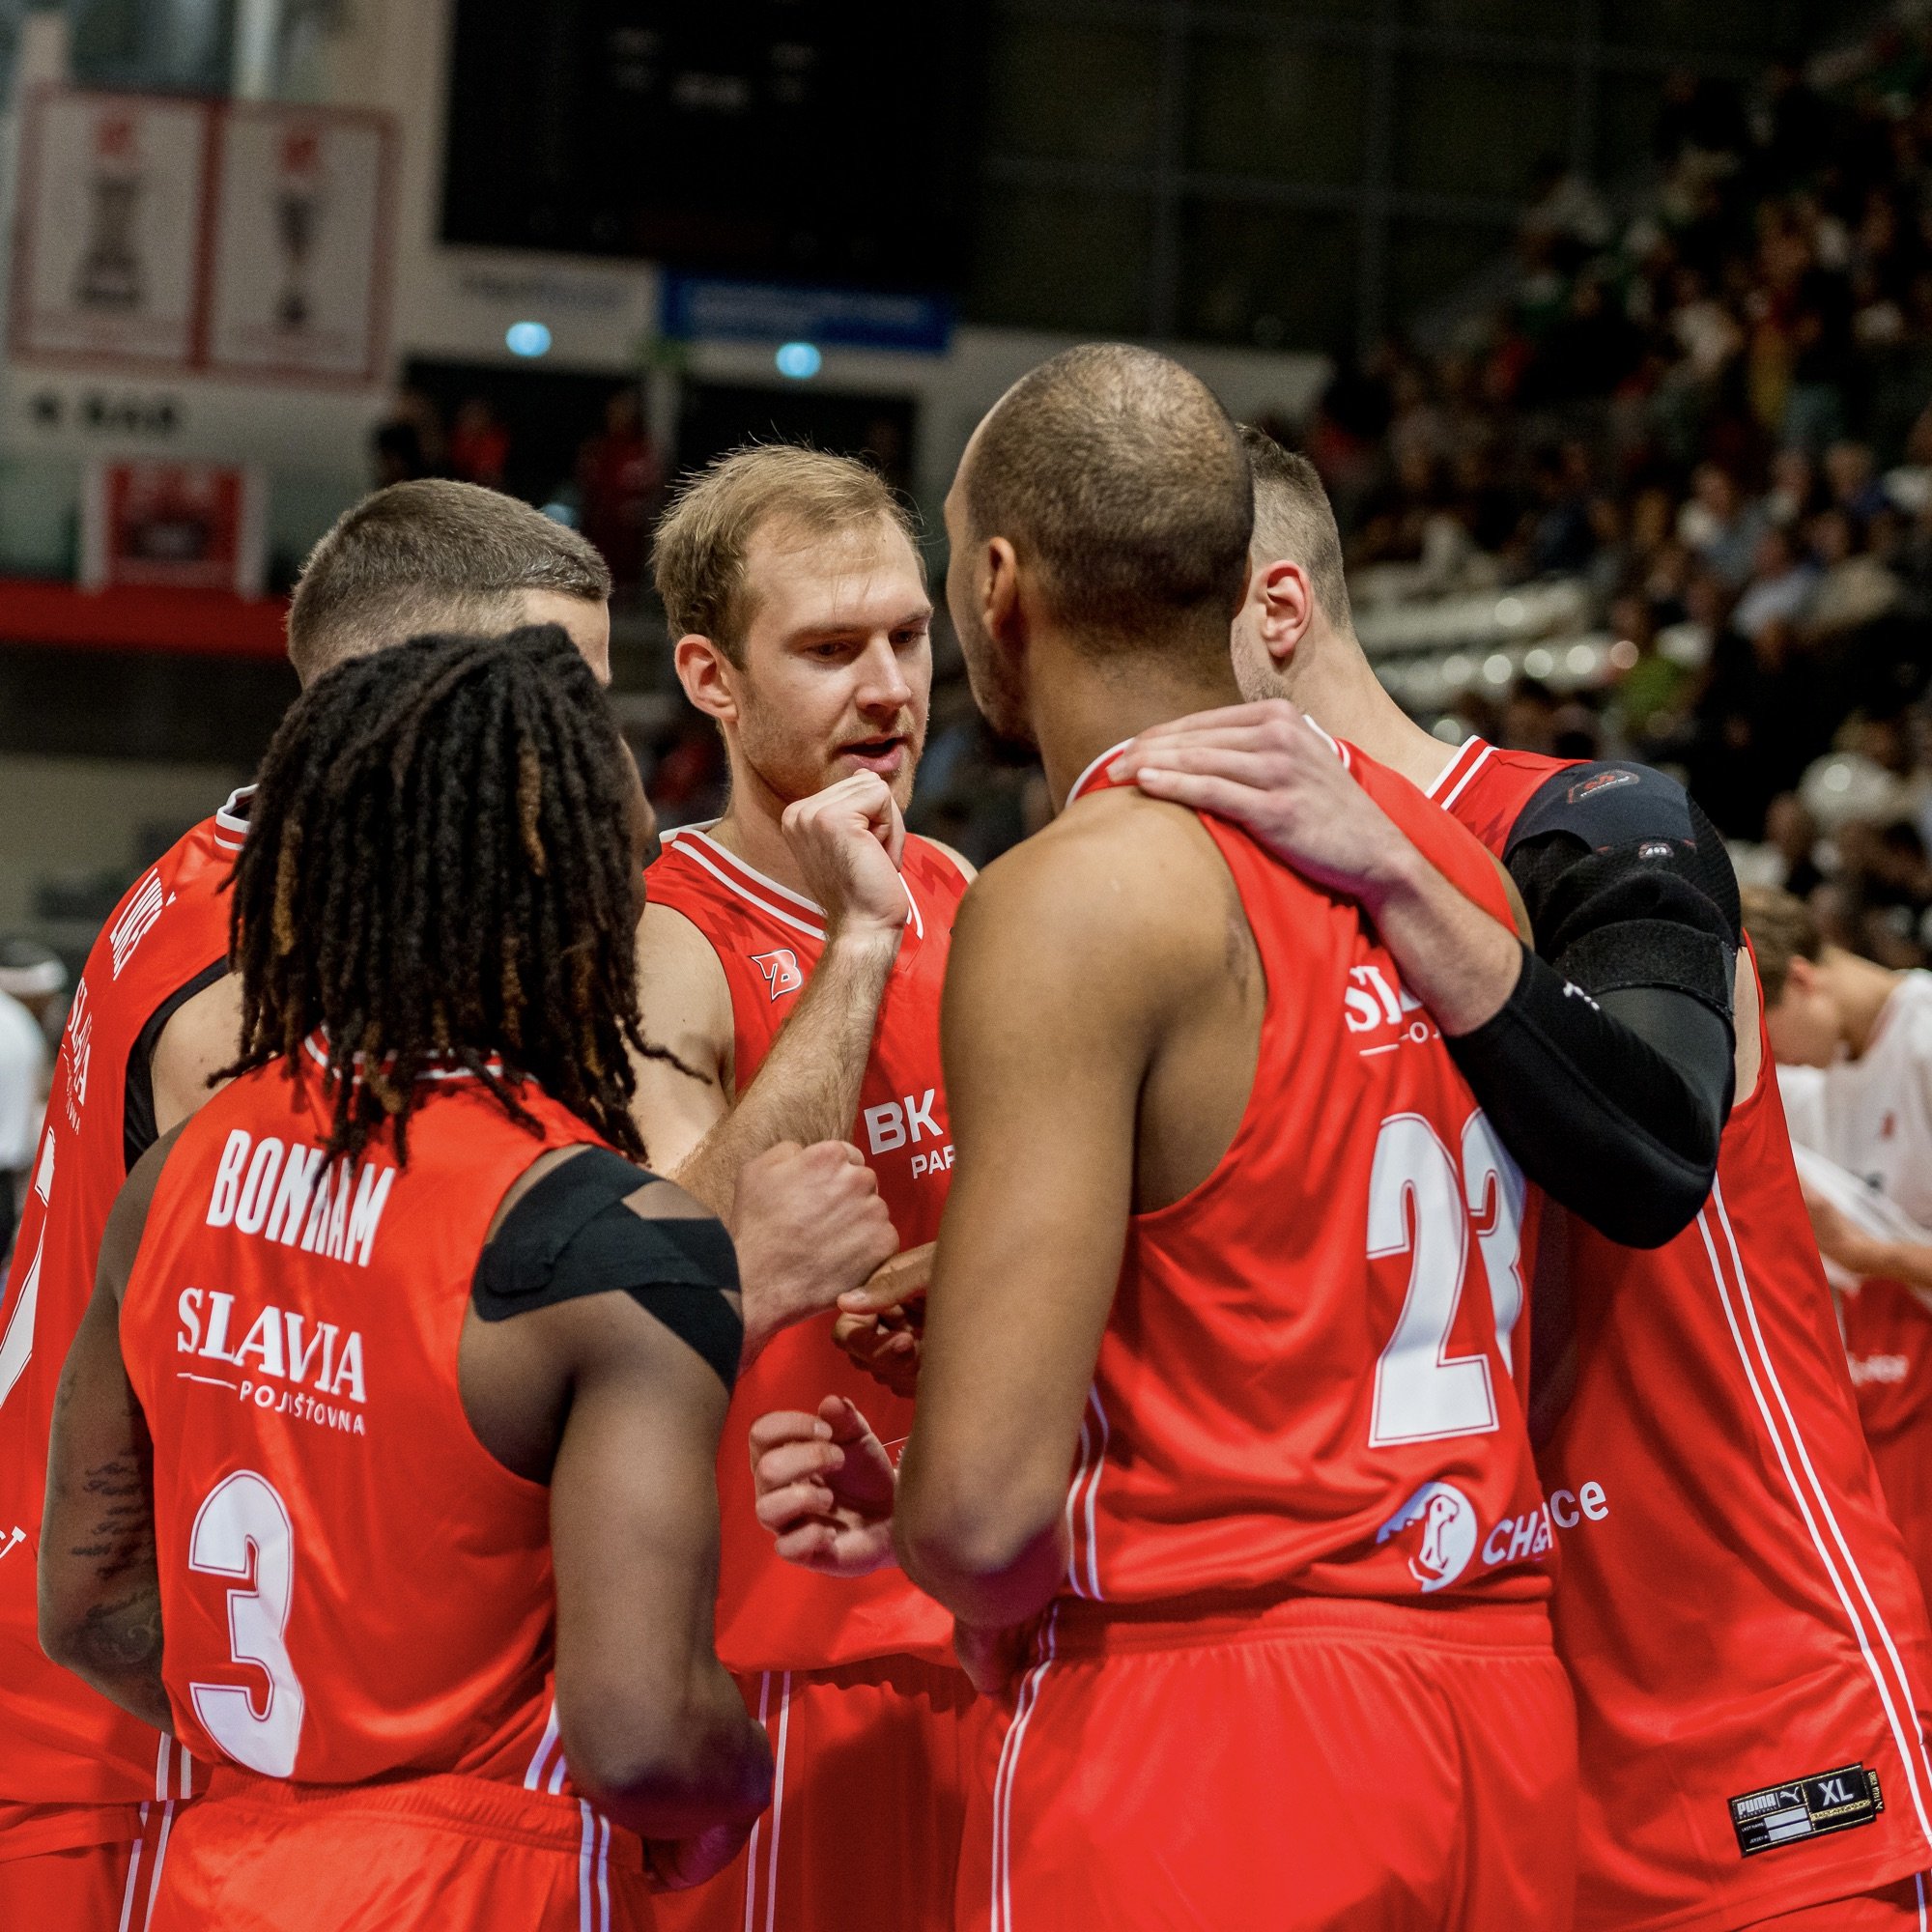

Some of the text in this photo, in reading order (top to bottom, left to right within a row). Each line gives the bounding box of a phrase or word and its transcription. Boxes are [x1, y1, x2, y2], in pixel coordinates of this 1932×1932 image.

[864, 1089, 943, 1155] BK
[177, 1287, 367, 1404] SLAVIA
[239, 1380, 365, 1436] POJIŠŤOVNA
[188, 1469, 305, 1778] 3
[1737, 1793, 1777, 1815] PUMA
[1818, 1777, 1855, 1806] XL
